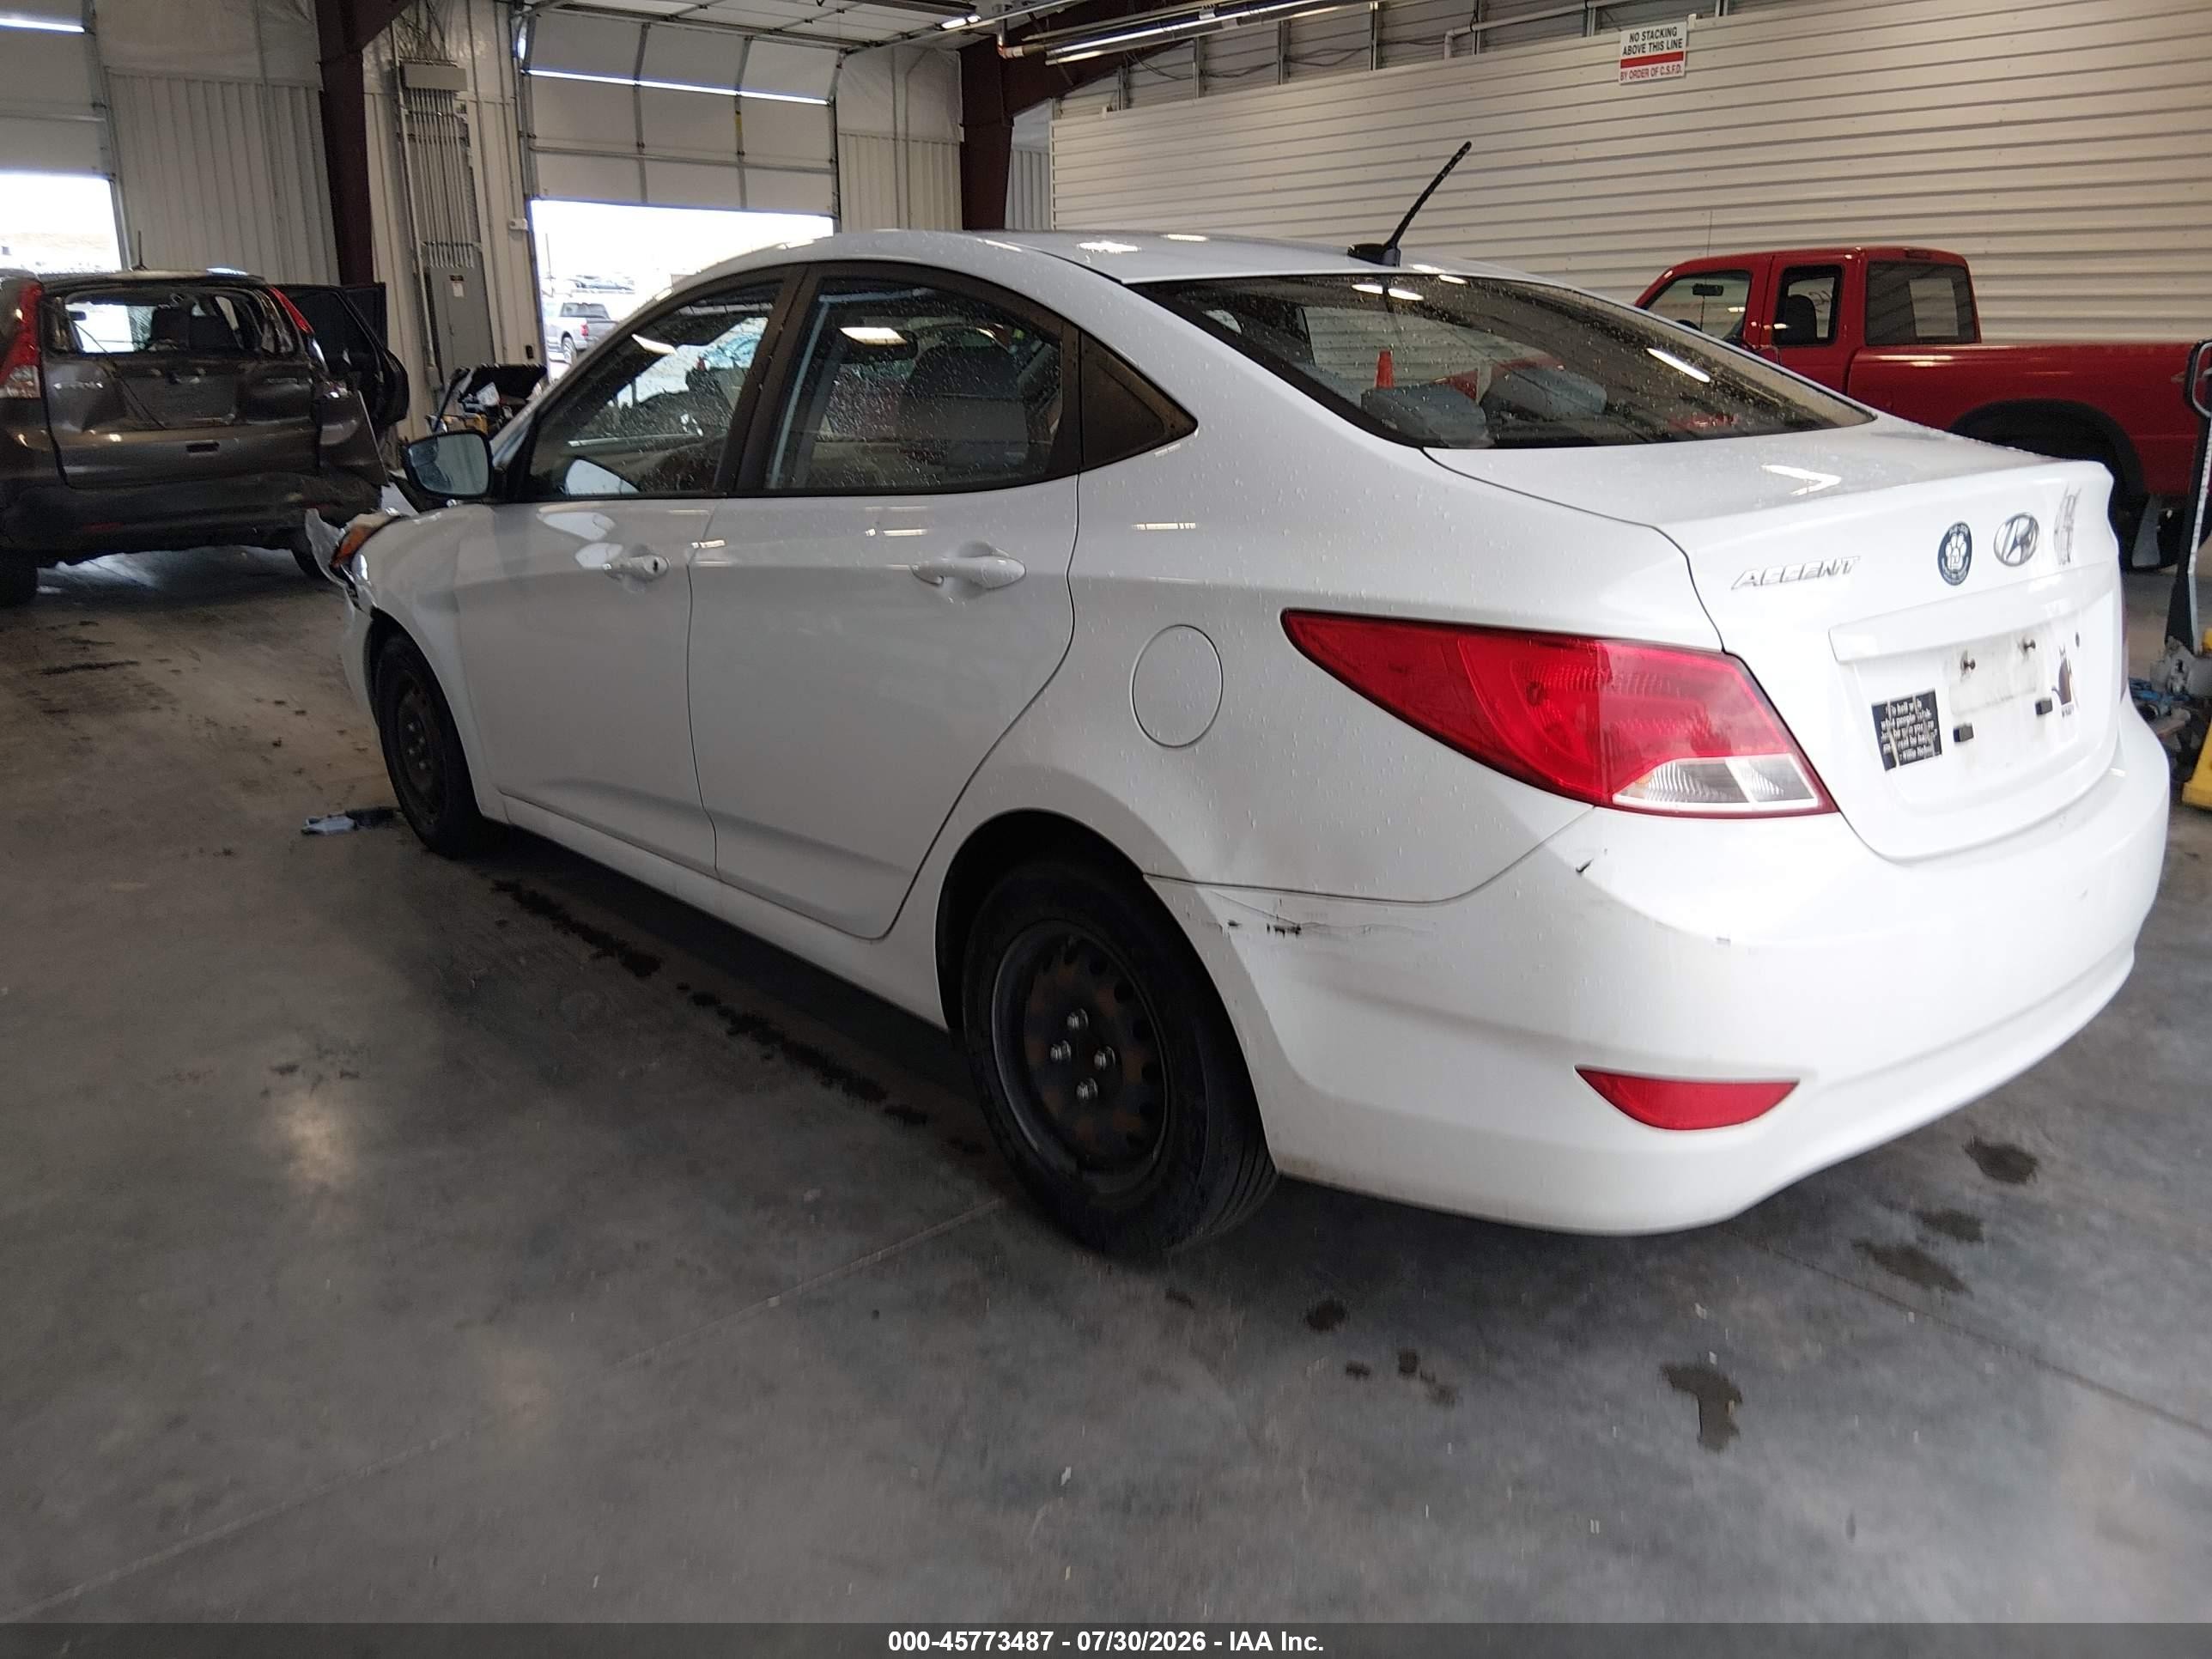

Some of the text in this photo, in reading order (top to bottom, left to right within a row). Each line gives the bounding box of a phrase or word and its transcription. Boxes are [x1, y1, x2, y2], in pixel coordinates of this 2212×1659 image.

[1629, 27, 1678, 43] NO STACKING
[1622, 38, 1683, 56] ABOVE THIS LINE
[1620, 70, 1628, 81] BY
[1629, 68, 1650, 79] ORDER
[1650, 66, 1658, 77] OF
[1730, 555, 1862, 591] ACCENT
